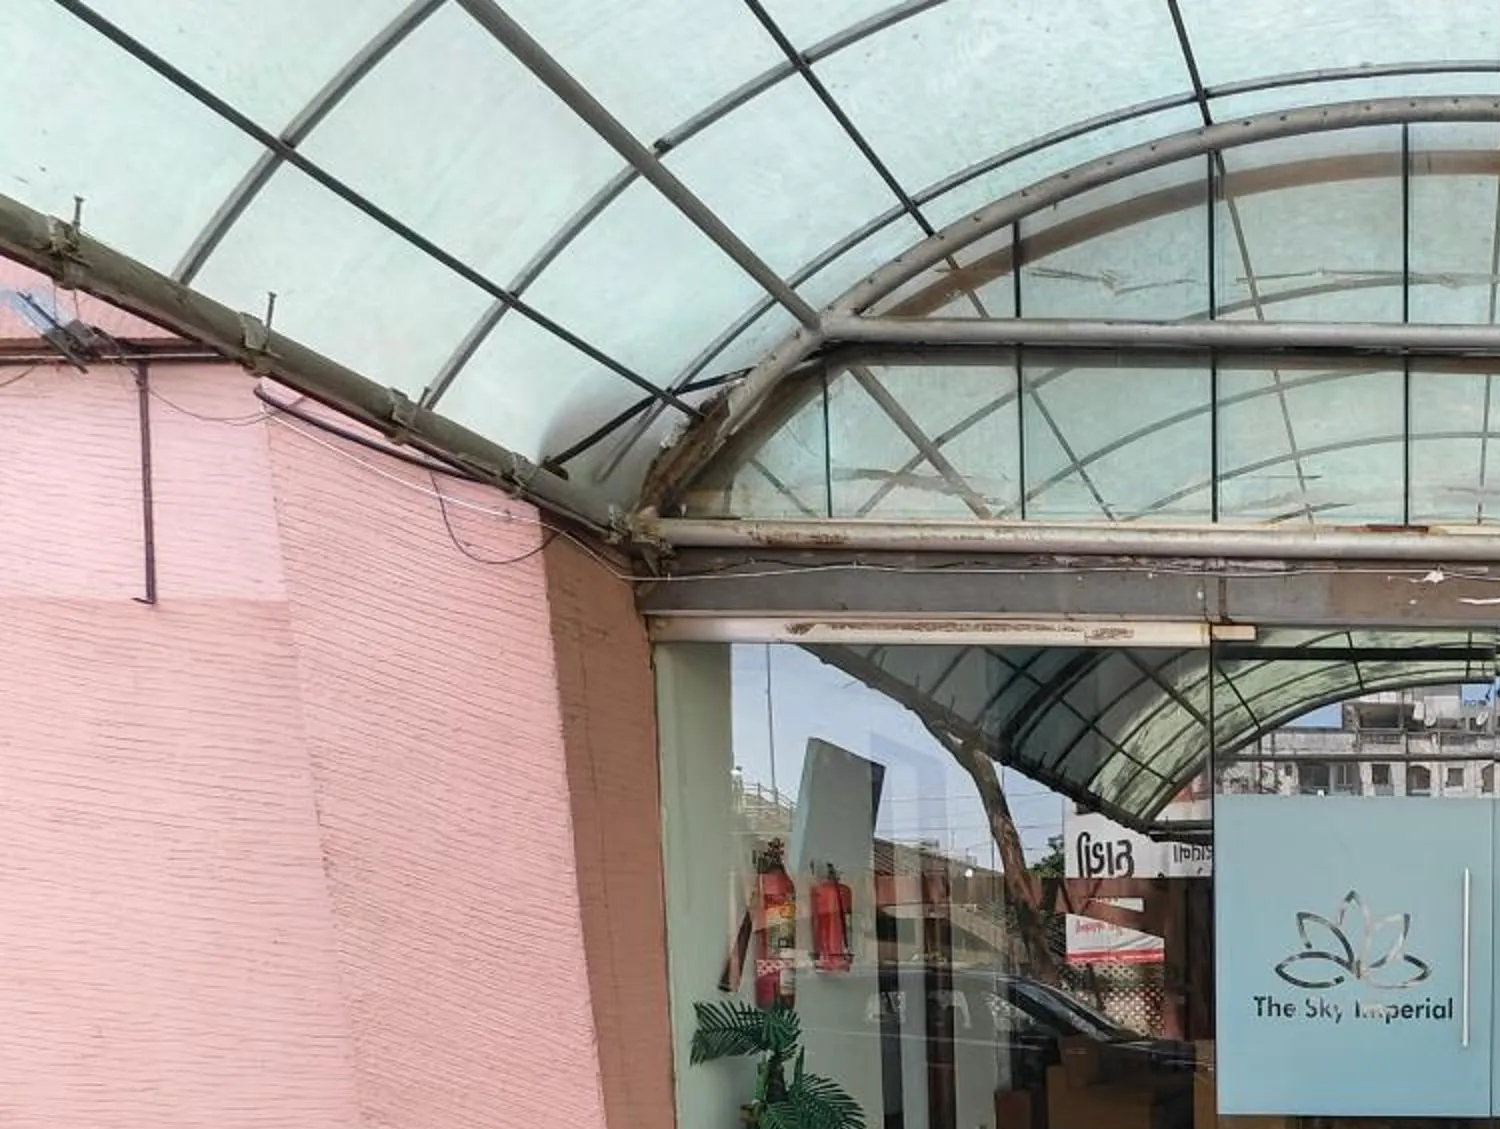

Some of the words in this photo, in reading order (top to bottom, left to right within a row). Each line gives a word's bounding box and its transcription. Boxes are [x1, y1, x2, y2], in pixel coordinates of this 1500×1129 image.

[1253, 995, 1297, 1018] The
[1305, 995, 1344, 1024] Sky
[1354, 995, 1455, 1025] Imperial
